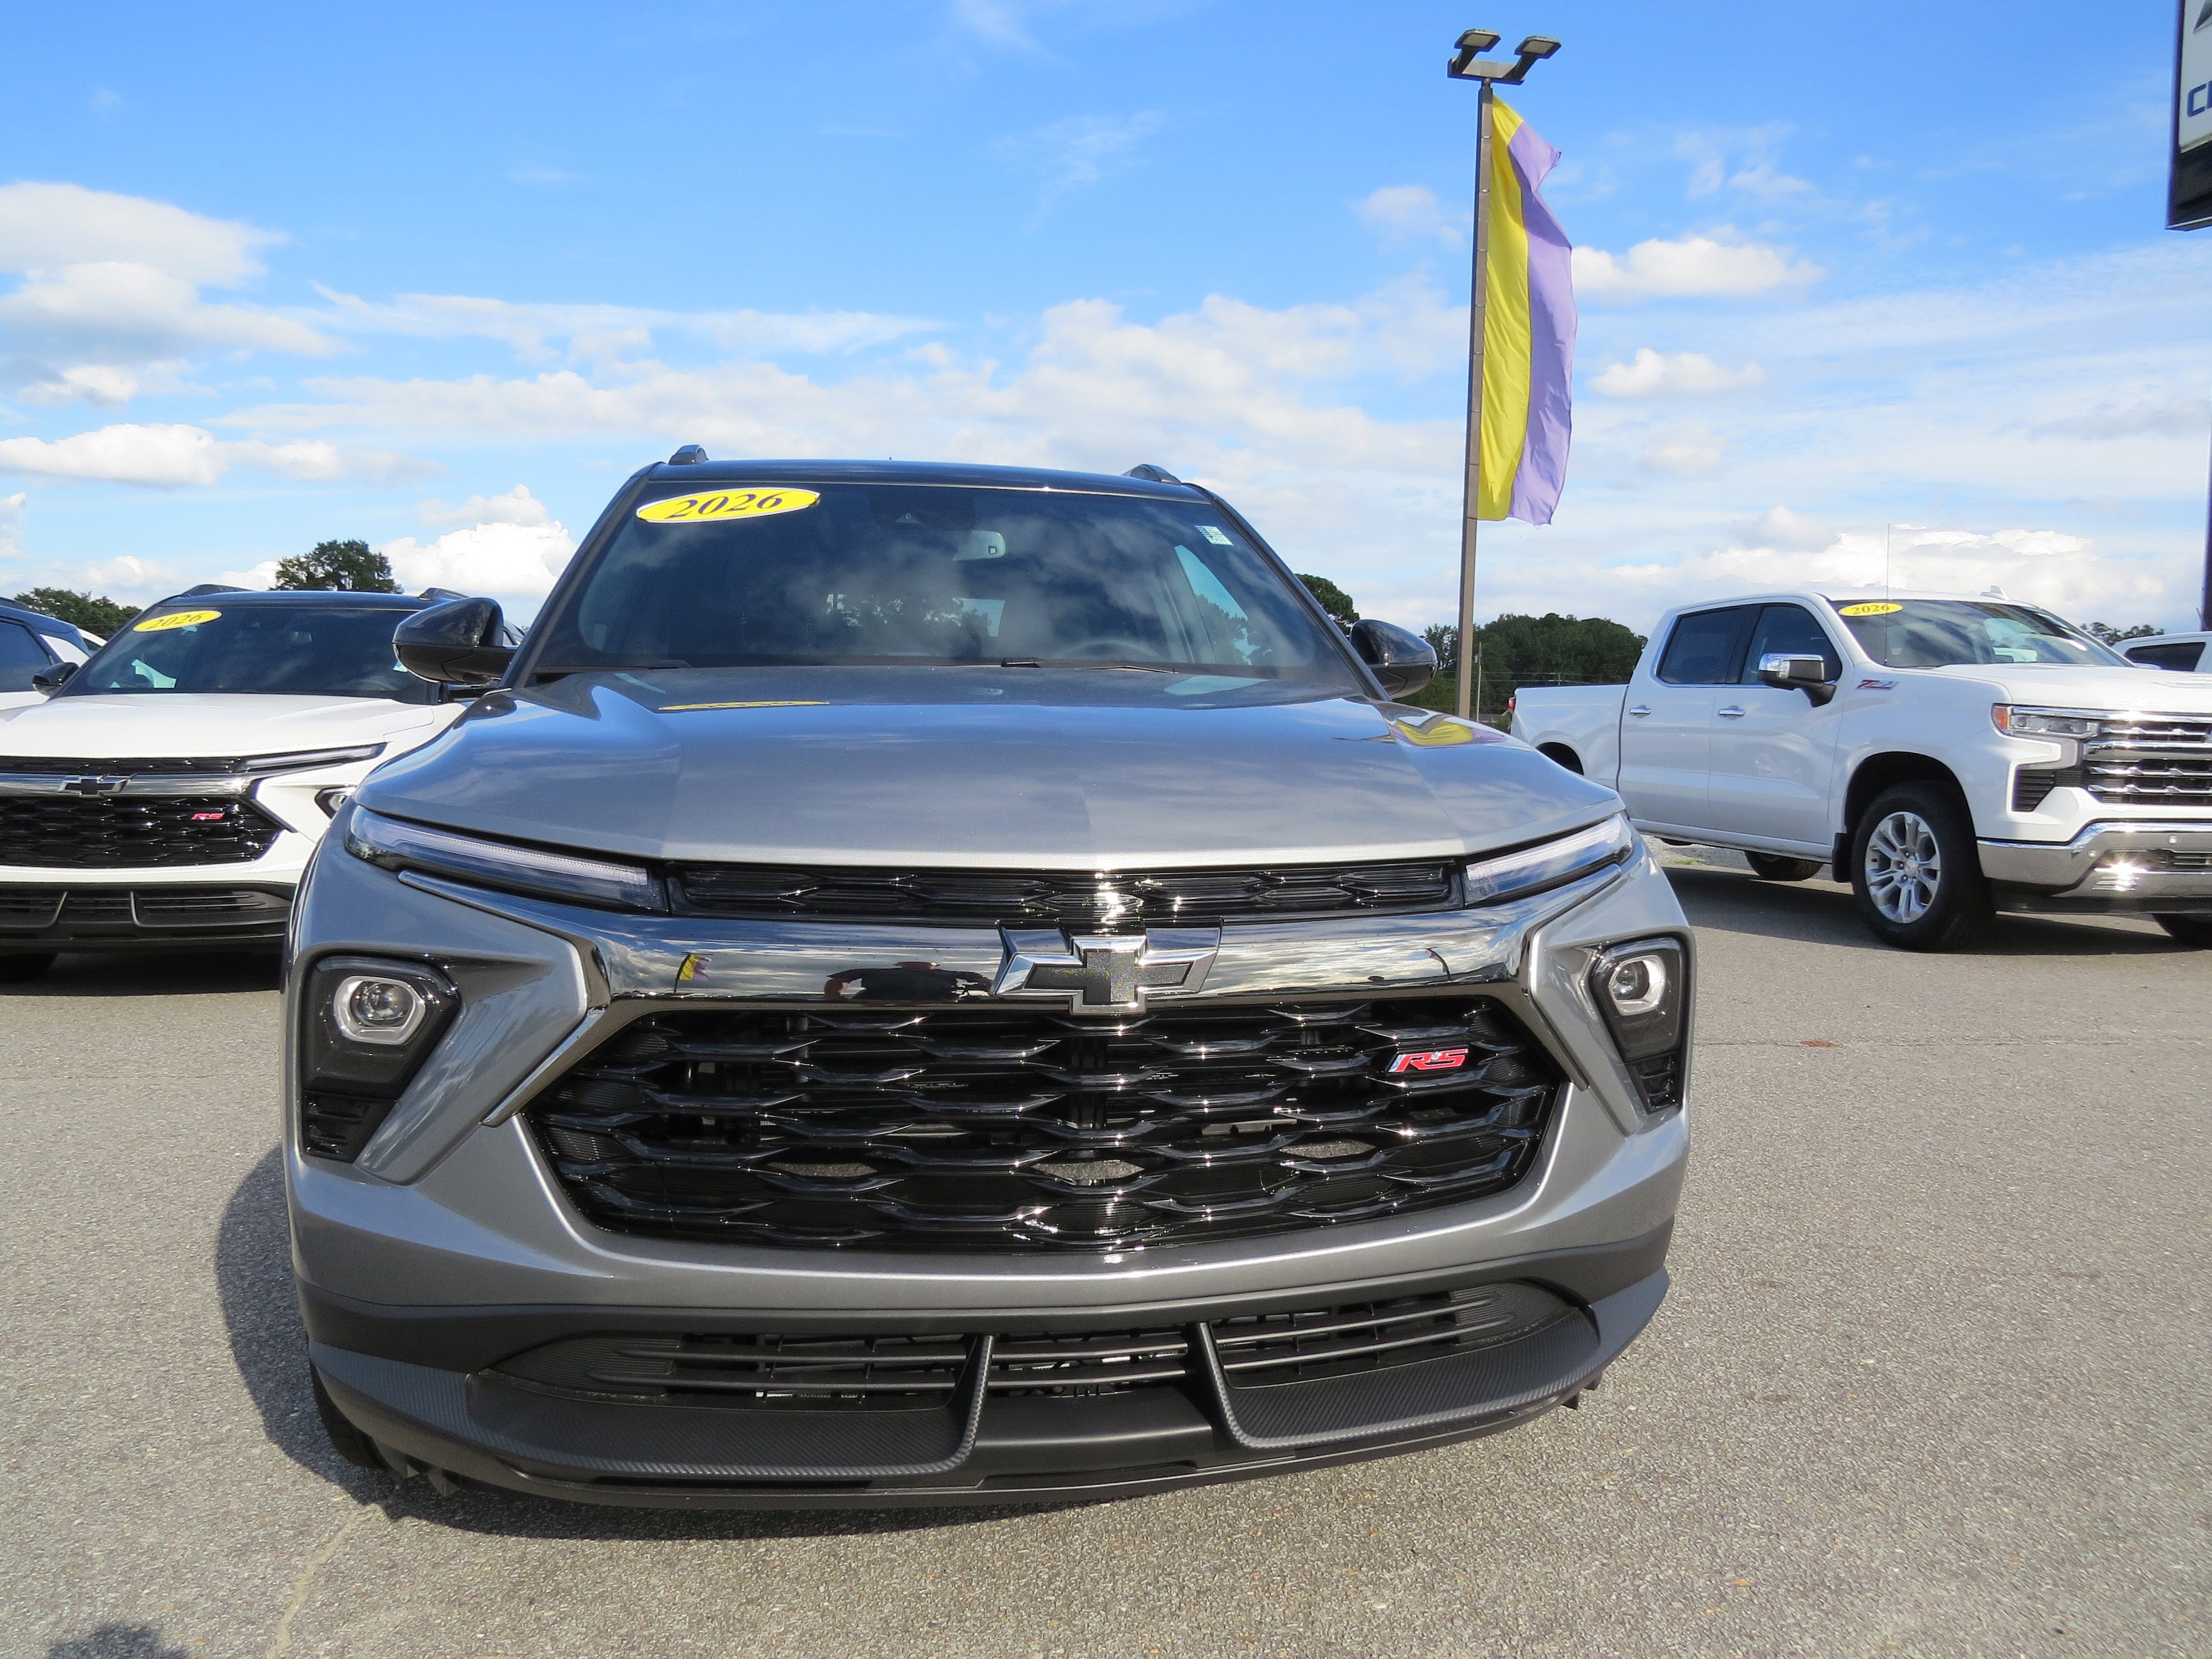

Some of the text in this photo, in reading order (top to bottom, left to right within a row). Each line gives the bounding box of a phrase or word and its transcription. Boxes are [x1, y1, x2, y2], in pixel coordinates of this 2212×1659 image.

[666, 491, 791, 519] 2026
[1852, 604, 1890, 614] 2026
[147, 613, 208, 629] 2026
[1388, 1048, 1468, 1072] RS
